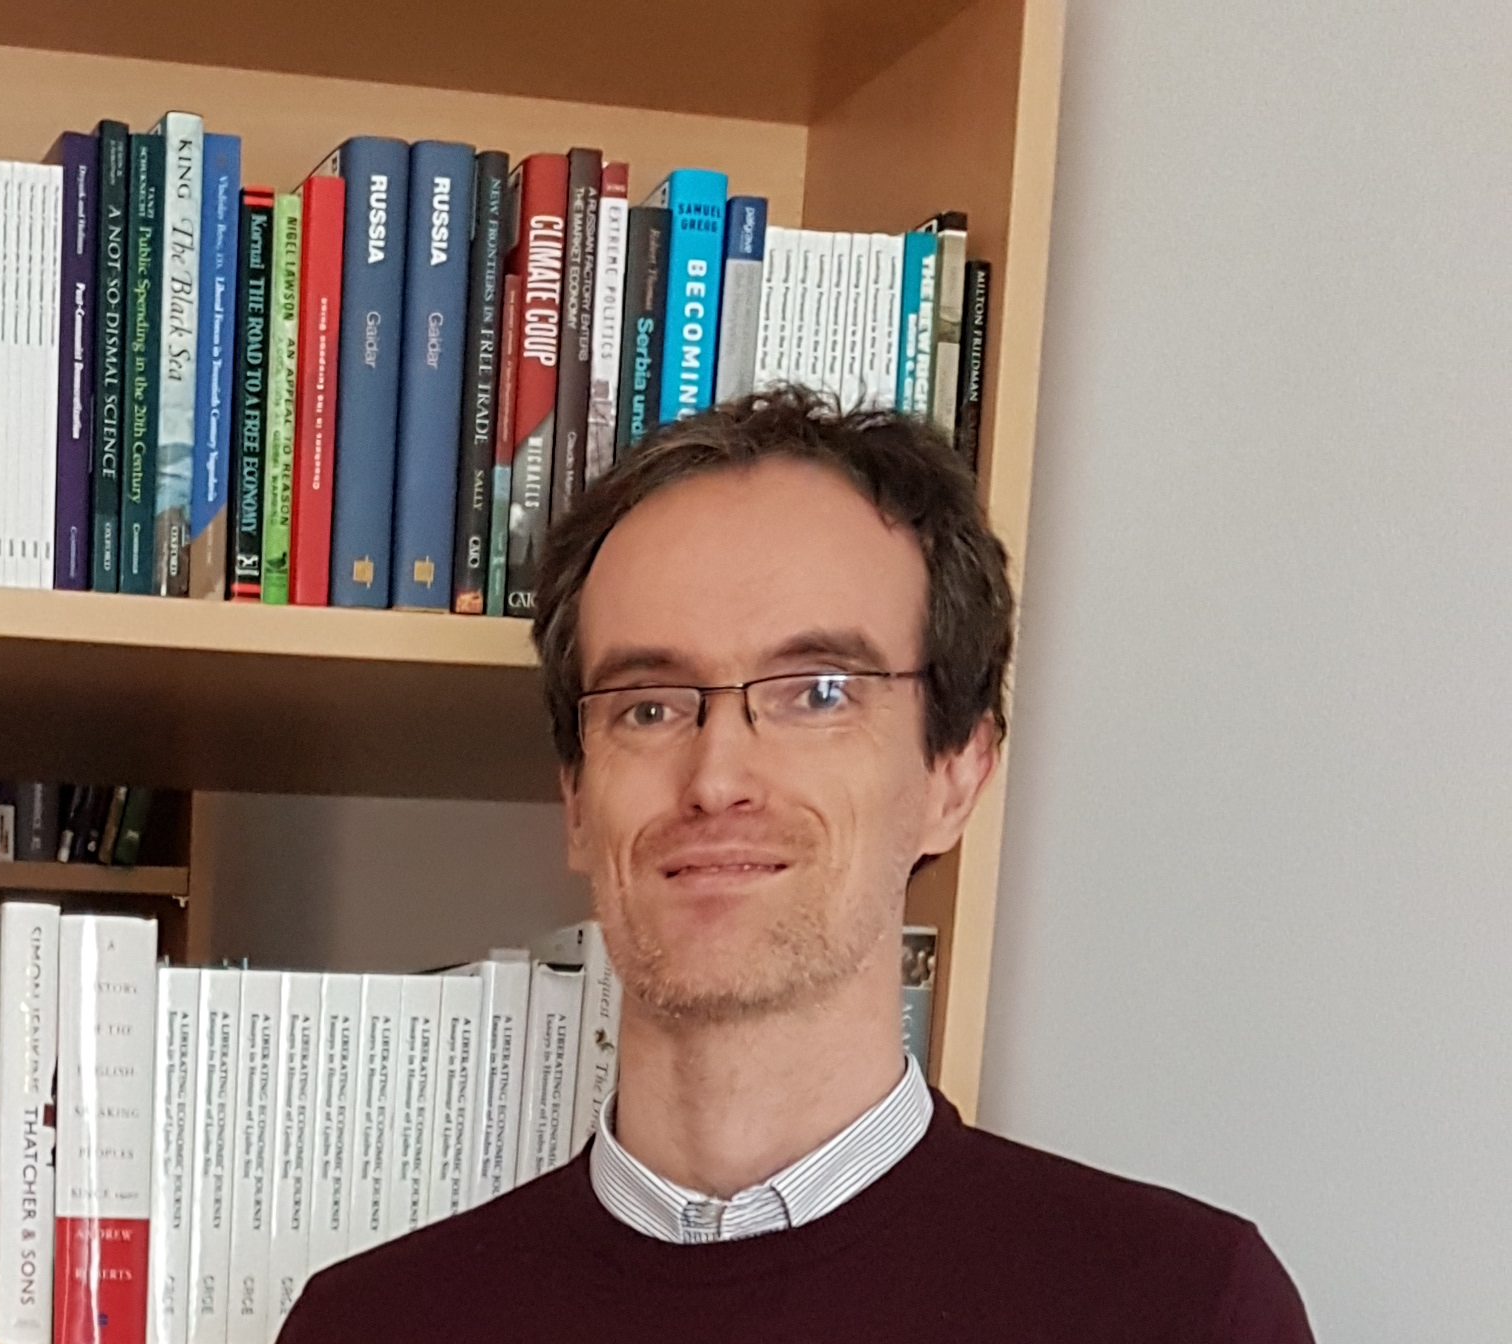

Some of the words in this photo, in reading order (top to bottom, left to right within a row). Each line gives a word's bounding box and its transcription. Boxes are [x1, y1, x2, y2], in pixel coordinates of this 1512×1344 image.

[177, 140, 194, 199] KING
[488, 178, 501, 215] NEW
[108, 206, 121, 218] A
[285, 216, 297, 255] NIGEL
[368, 174, 388, 263] RUSSIA
[430, 177, 450, 265] RUSSIA
[136, 226, 152, 273] Public
[170, 218, 195, 264] The
[249, 214, 267, 269] Kornai
[484, 220, 498, 301] FRONTIERS
[525, 216, 563, 302] CLIMATE
[131, 280, 150, 351] Spending
[170, 276, 193, 336] Black
[248, 278, 266, 313] THE
[283, 262, 297, 320] LAWSON
[482, 306, 494, 322] IN
[972, 270, 986, 322] MILTON
[135, 357, 147, 370] in
[246, 318, 264, 364] ROAD
[285, 338, 296, 360] AN
[364, 311, 381, 368] Gaidar
[426, 312, 443, 369] Gaidar
[479, 328, 496, 376] FREE
[523, 309, 557, 366] COUP
[634, 317, 654, 390] Serbia
[134, 376, 147, 400] the
[169, 349, 190, 382] Sea
[246, 369, 262, 392] TO
[969, 330, 982, 401] FRIEDMAN
[133, 405, 147, 437] 20th
[246, 395, 261, 405] A
[283, 367, 295, 426] APPEAL
[474, 382, 493, 444] TRADE
[101, 395, 117, 477] SCIENCE
[243, 410, 261, 452] FREE
[282, 437, 293, 456] TO
[129, 441, 145, 501] Century
[241, 457, 260, 534] ECONOMY
[279, 463, 291, 526] REASON
[472, 469, 484, 510] SALLY
[525, 437, 543, 508] MICHAELS
[23, 1107, 38, 1219] THATCHER
[22, 1229, 36, 1240] &
[21, 1250, 35, 1305] SONS
